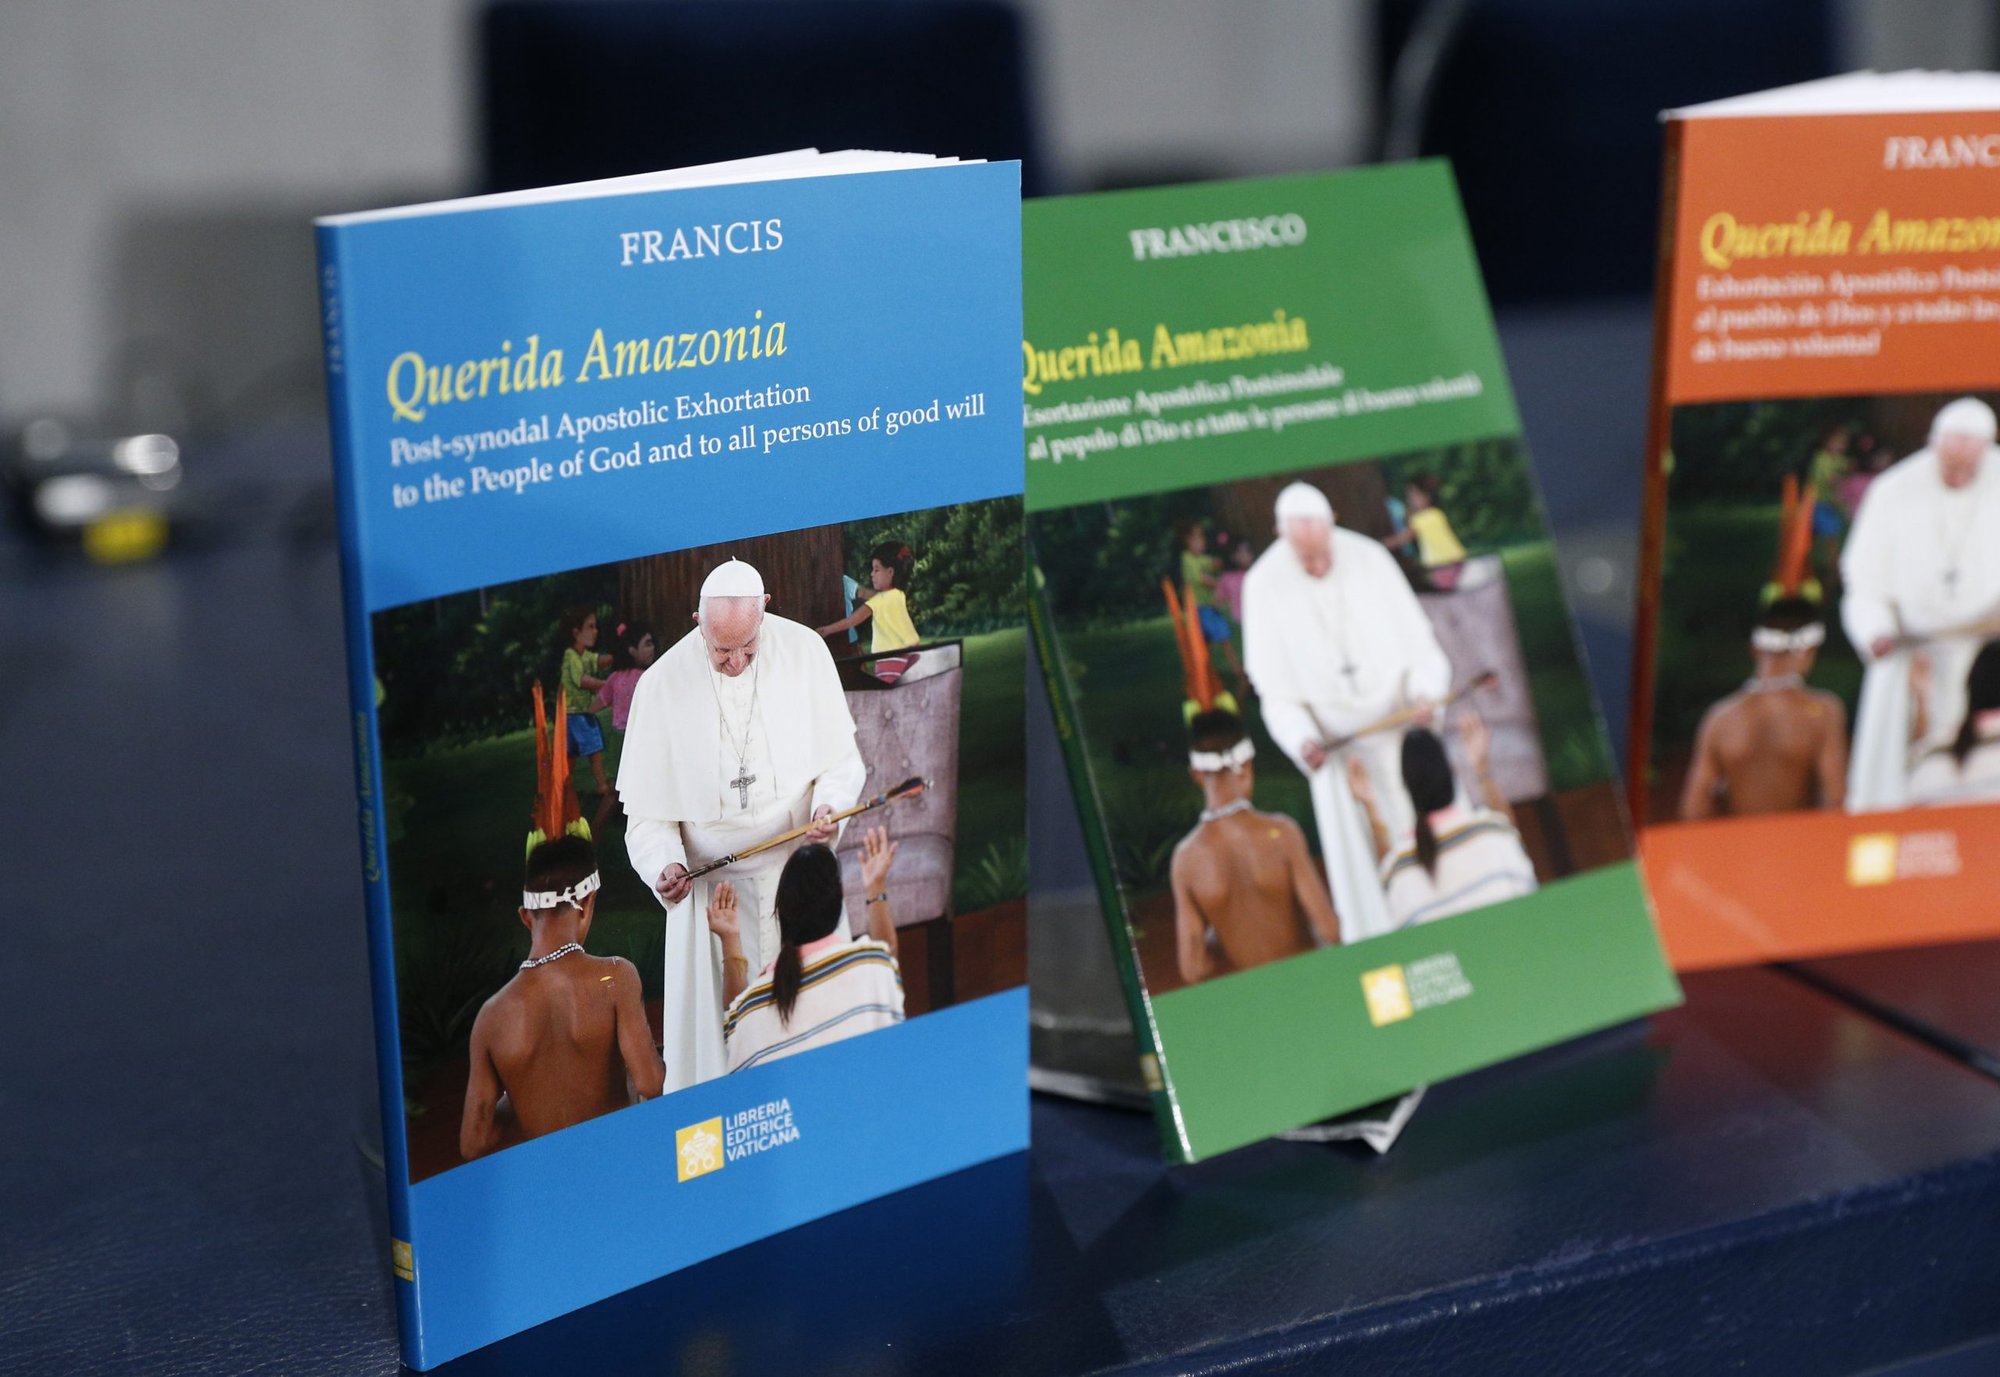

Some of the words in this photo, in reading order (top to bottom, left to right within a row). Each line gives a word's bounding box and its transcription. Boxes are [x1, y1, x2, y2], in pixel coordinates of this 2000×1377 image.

[619, 218, 784, 266] FRANCIS
[1129, 213, 1307, 260] FRANCESCO
[1701, 208, 1852, 269] Querida
[1150, 308, 1310, 371] Amazonia
[387, 333, 565, 423] Querida
[575, 310, 788, 382] Amazonia
[389, 415, 549, 467] Post-synodal
[556, 400, 669, 443] Apostolic
[675, 383, 811, 420] Exhortation
[1028, 435, 1048, 460] al
[1050, 427, 1118, 463] popolo
[393, 483, 419, 508] to
[423, 473, 465, 503] the
[470, 457, 553, 494] People
[559, 450, 584, 478] of
[589, 441, 641, 473] God
[648, 434, 693, 464] and
[699, 433, 722, 456] to
[728, 425, 756, 451] all
[762, 417, 851, 453] persons
[858, 407, 881, 432] of
[885, 399, 940, 435] good
[945, 393, 985, 419] will
[726, 1098, 791, 1130] LIBRERIA
[726, 1112, 793, 1147] EDITRICE
[726, 1126, 800, 1161] VATICANA
